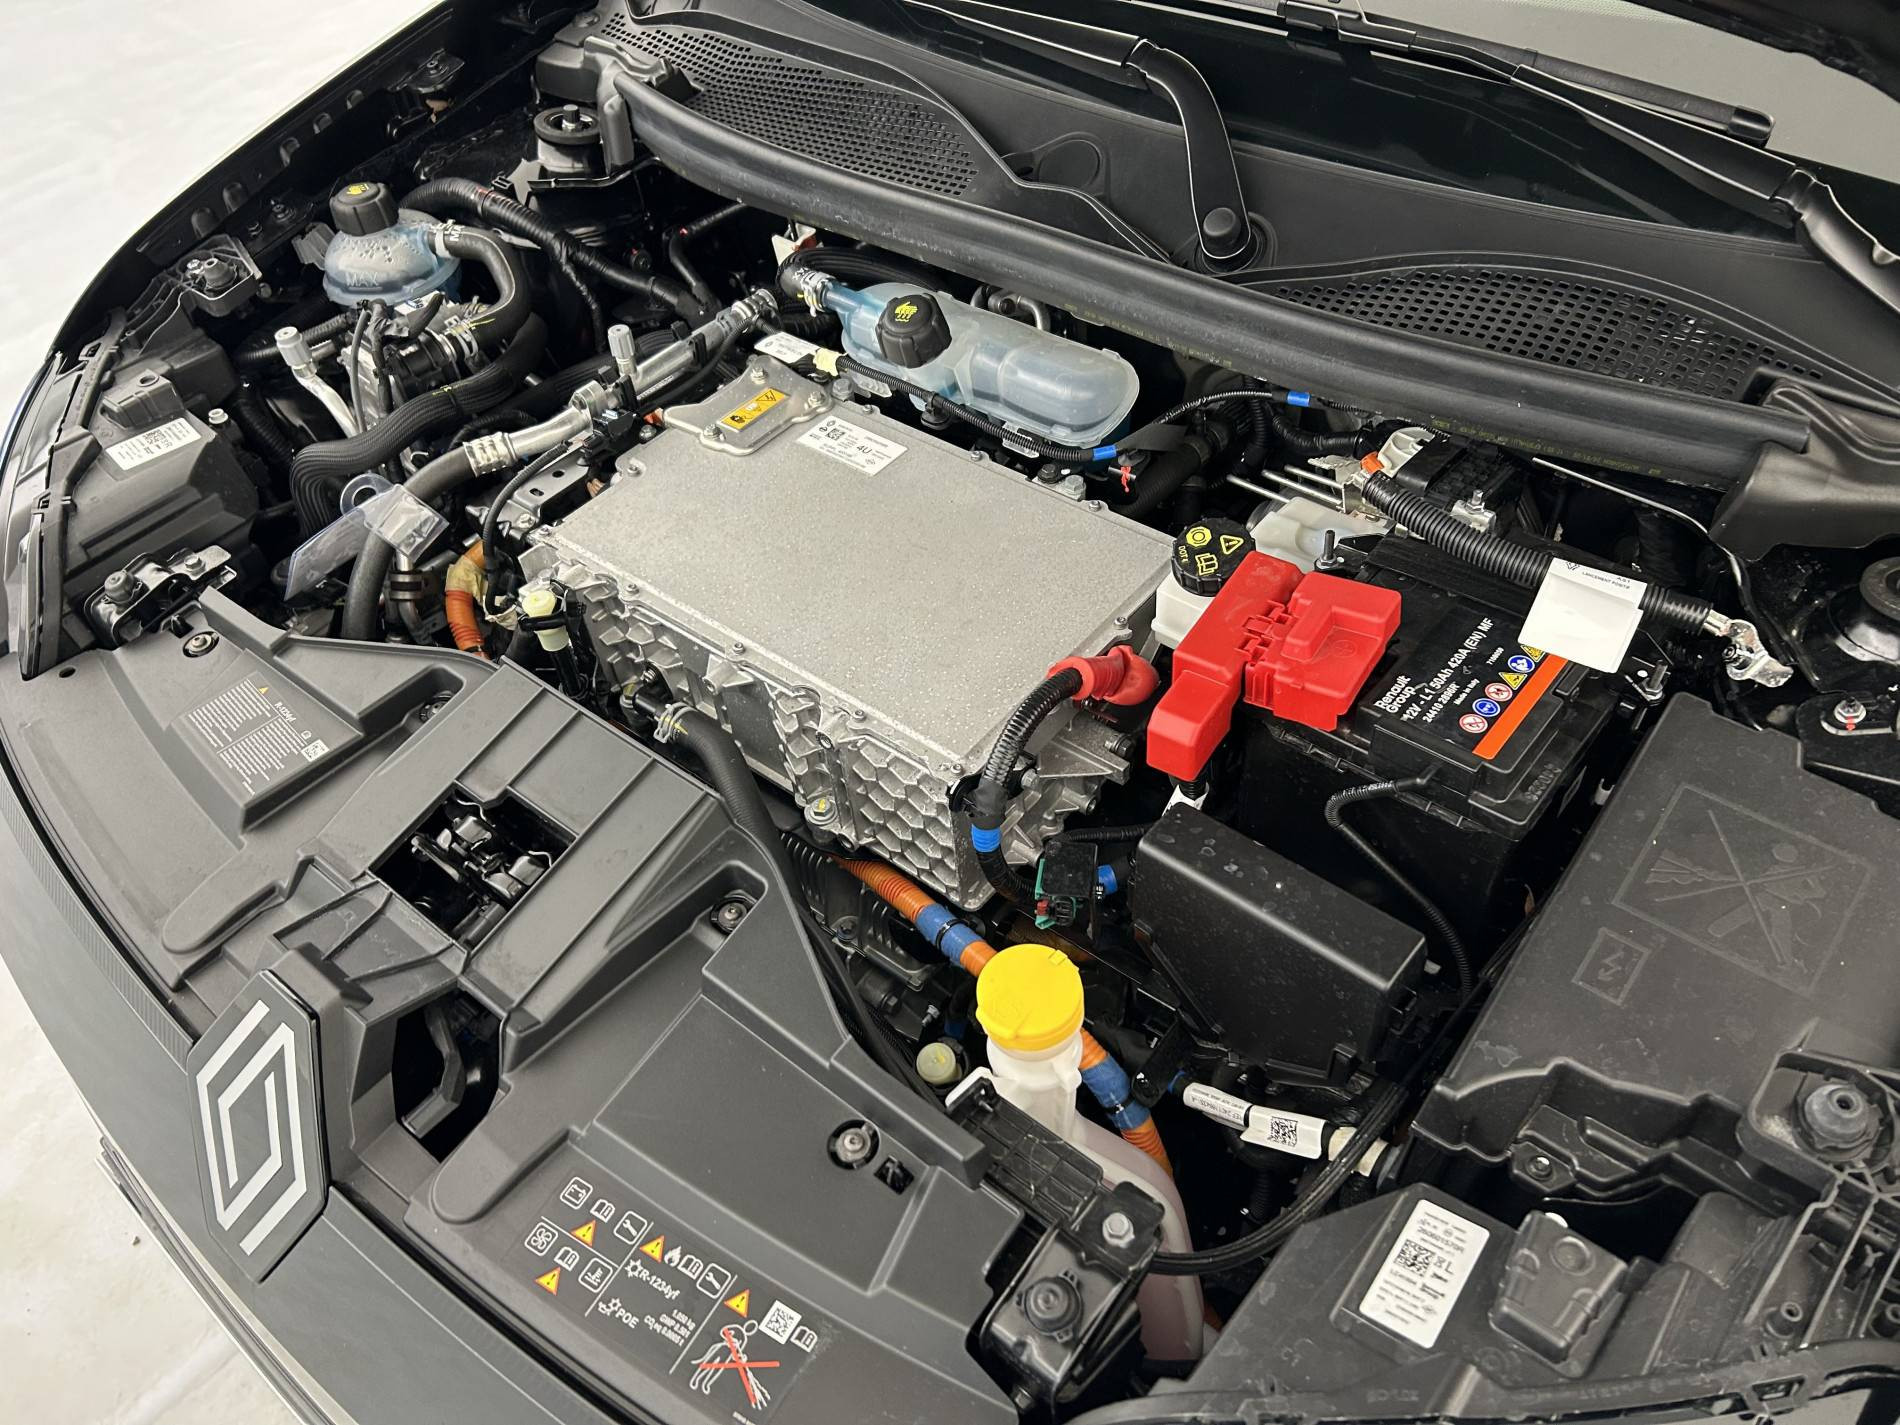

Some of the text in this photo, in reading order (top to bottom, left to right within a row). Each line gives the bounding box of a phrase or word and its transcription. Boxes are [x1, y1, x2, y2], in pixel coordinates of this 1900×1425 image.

[345, 271, 379, 287] MAX
[1403, 703, 1422, 720] 12V
[1429, 668, 1454, 689] 50Ah
[1448, 648, 1471, 669] 420A
[1463, 630, 1487, 650] (EN)
[1478, 617, 1494, 631] MF
[1374, 676, 1411, 709] Renault
[1386, 686, 1416, 713] Group
[1422, 703, 1443, 723] 24410
[640, 1268, 681, 1300] R-1234yf
[615, 1308, 640, 1329] POE
